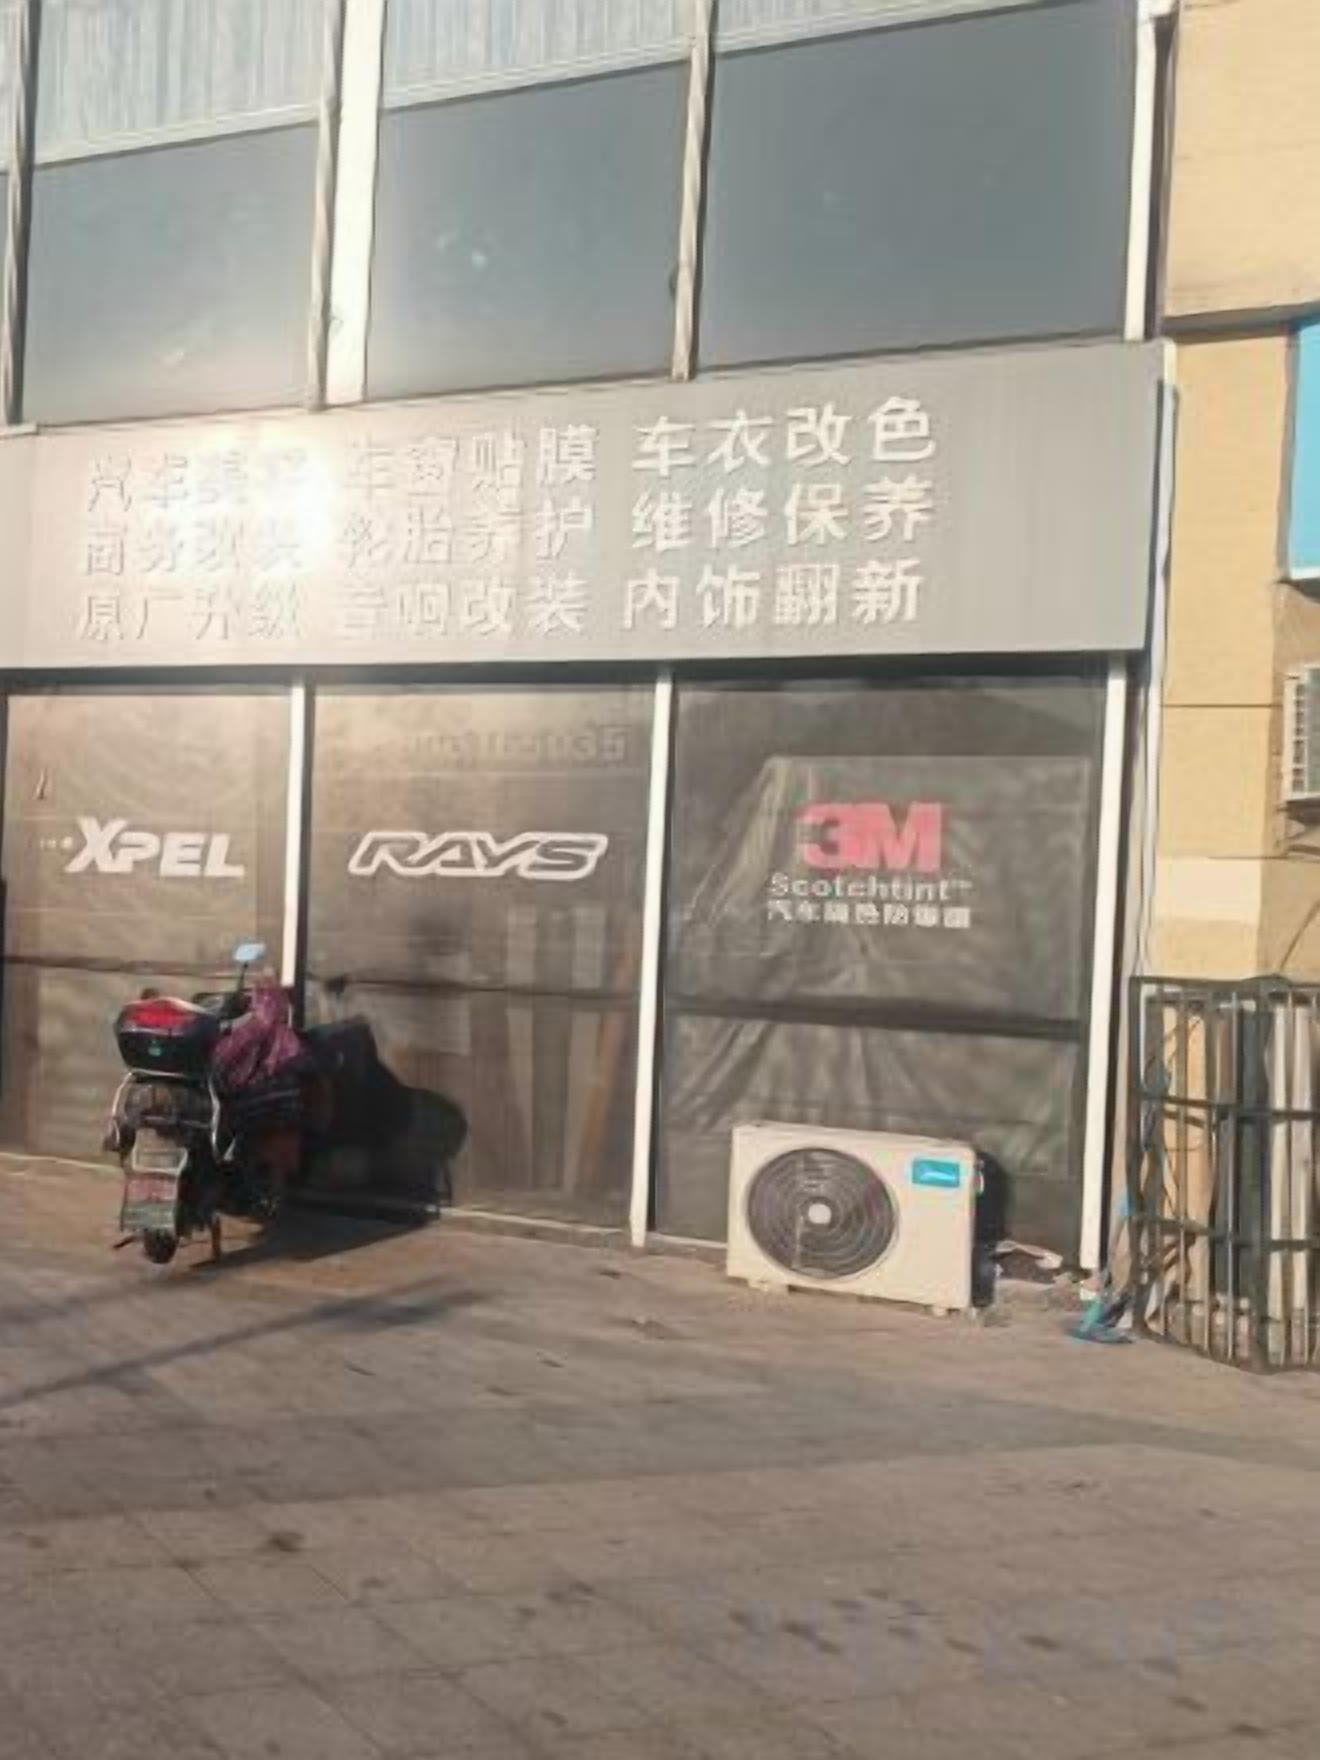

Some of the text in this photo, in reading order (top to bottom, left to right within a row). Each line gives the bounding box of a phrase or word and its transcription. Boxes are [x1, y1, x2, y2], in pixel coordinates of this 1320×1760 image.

[631, 396, 938, 478] 车衣改色
[630, 474, 935, 553] 维修保养
[80, 585, 300, 643] 原厂升级
[622, 557, 925, 630] 内饰翻新
[64, 816, 245, 877] XPEL
[347, 830, 609, 881] RAYS
[796, 801, 942, 873] 3M
